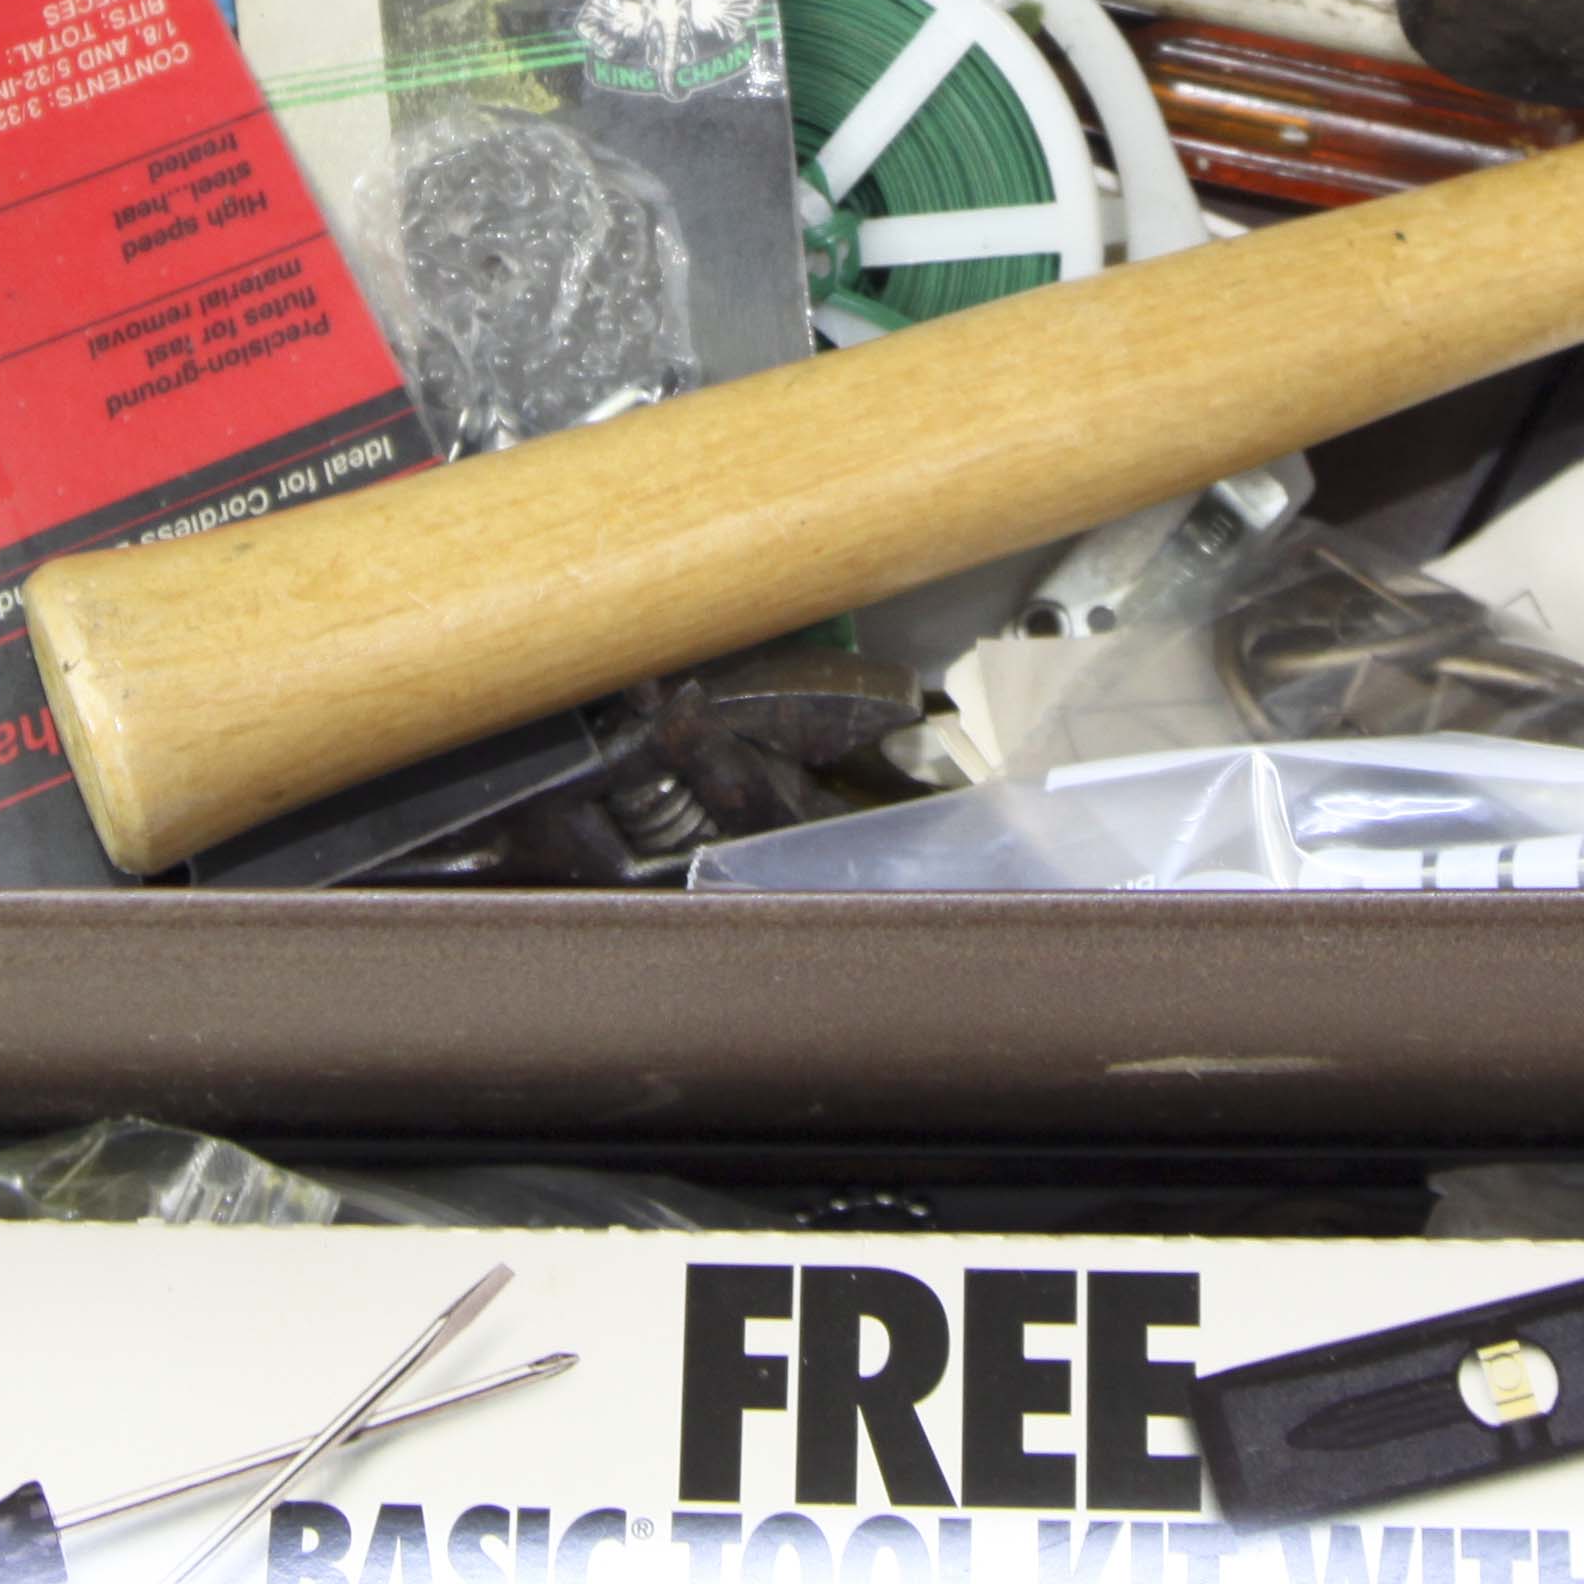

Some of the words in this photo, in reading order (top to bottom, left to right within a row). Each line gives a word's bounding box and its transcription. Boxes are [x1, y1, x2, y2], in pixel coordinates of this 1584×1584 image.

[5, 21, 97, 64] TOTAL:
[77, 36, 129, 71] AND
[135, 18, 177, 47] 1/8,
[47, 41, 191, 108] CONTENTS:
[593, 57, 656, 92] KING
[676, 39, 754, 88] CHAIN
[147, 131, 238, 184] treated
[206, 190, 268, 229] High
[122, 215, 199, 264] speed
[198, 257, 304, 316] material
[243, 284, 317, 327] flutes
[87, 302, 193, 361] removal
[145, 334, 195, 369] fast
[202, 319, 238, 346] for
[105, 312, 332, 420] Precision-ground
[276, 462, 321, 500] for
[323, 432, 394, 484] Ideal
[140, 484, 270, 547] Cordless
[678, 1262, 1204, 1514] FREE
